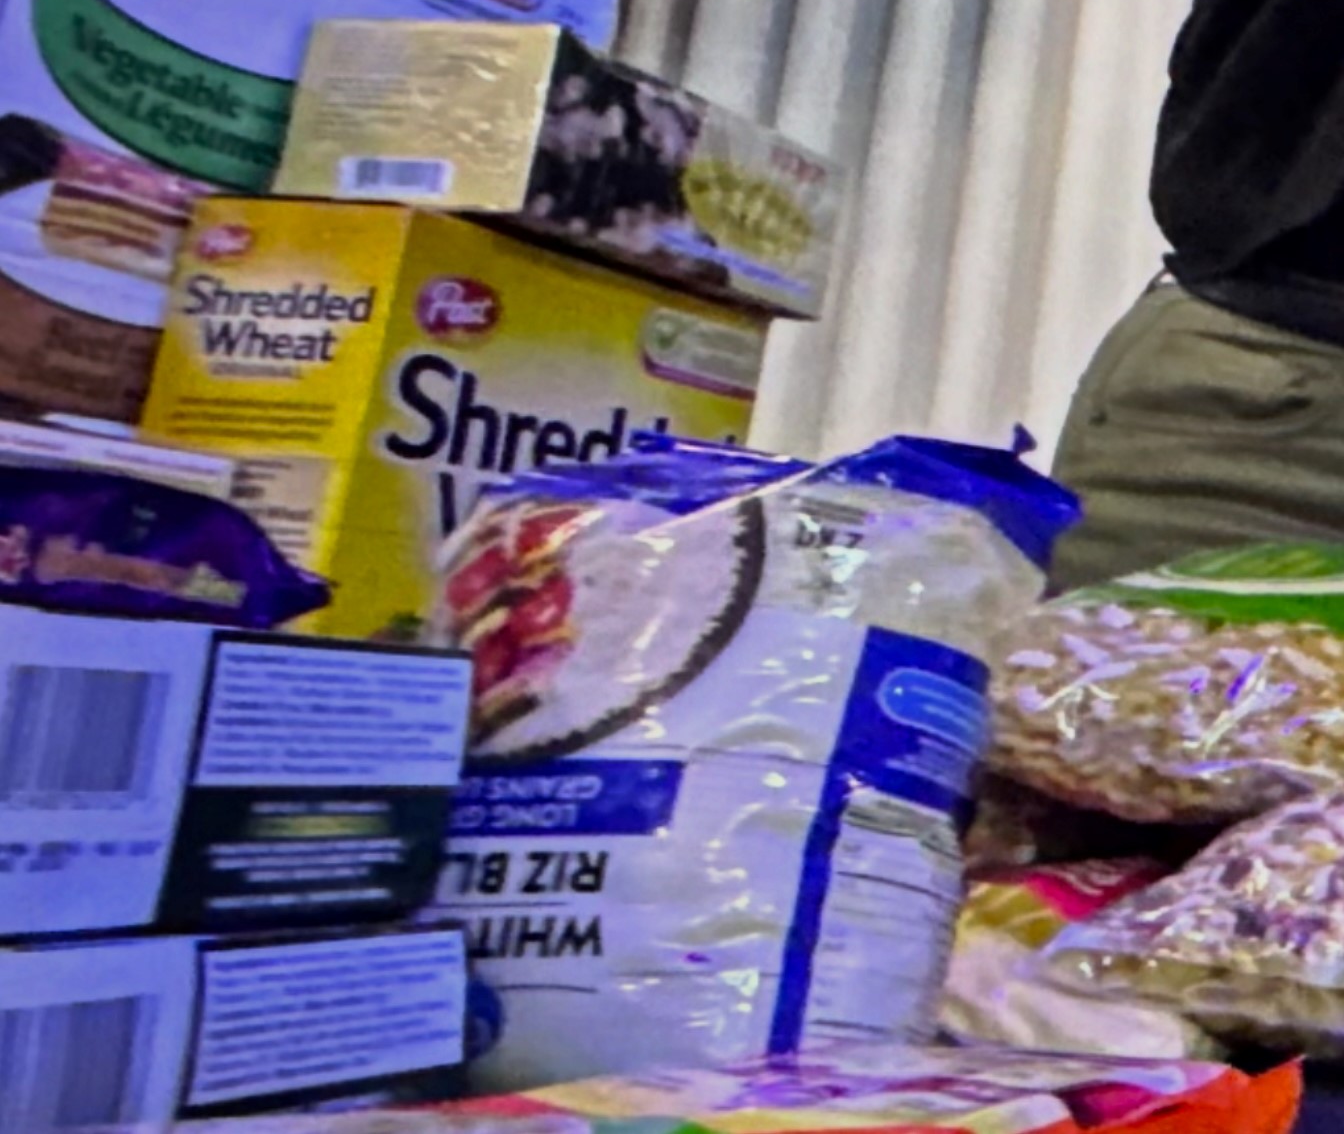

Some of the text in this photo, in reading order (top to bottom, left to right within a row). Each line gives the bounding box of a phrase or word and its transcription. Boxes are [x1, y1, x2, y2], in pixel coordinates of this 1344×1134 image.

[71, 14, 245, 119] Vegetable
[184, 273, 378, 323] Shredded
[427, 281, 495, 326] Post
[204, 319, 338, 362] Wheat
[385, 354, 680, 474] Shred
[490, 803, 579, 828] LONG
[442, 851, 609, 896] RIZ BL
[467, 915, 604, 959] WHIT
